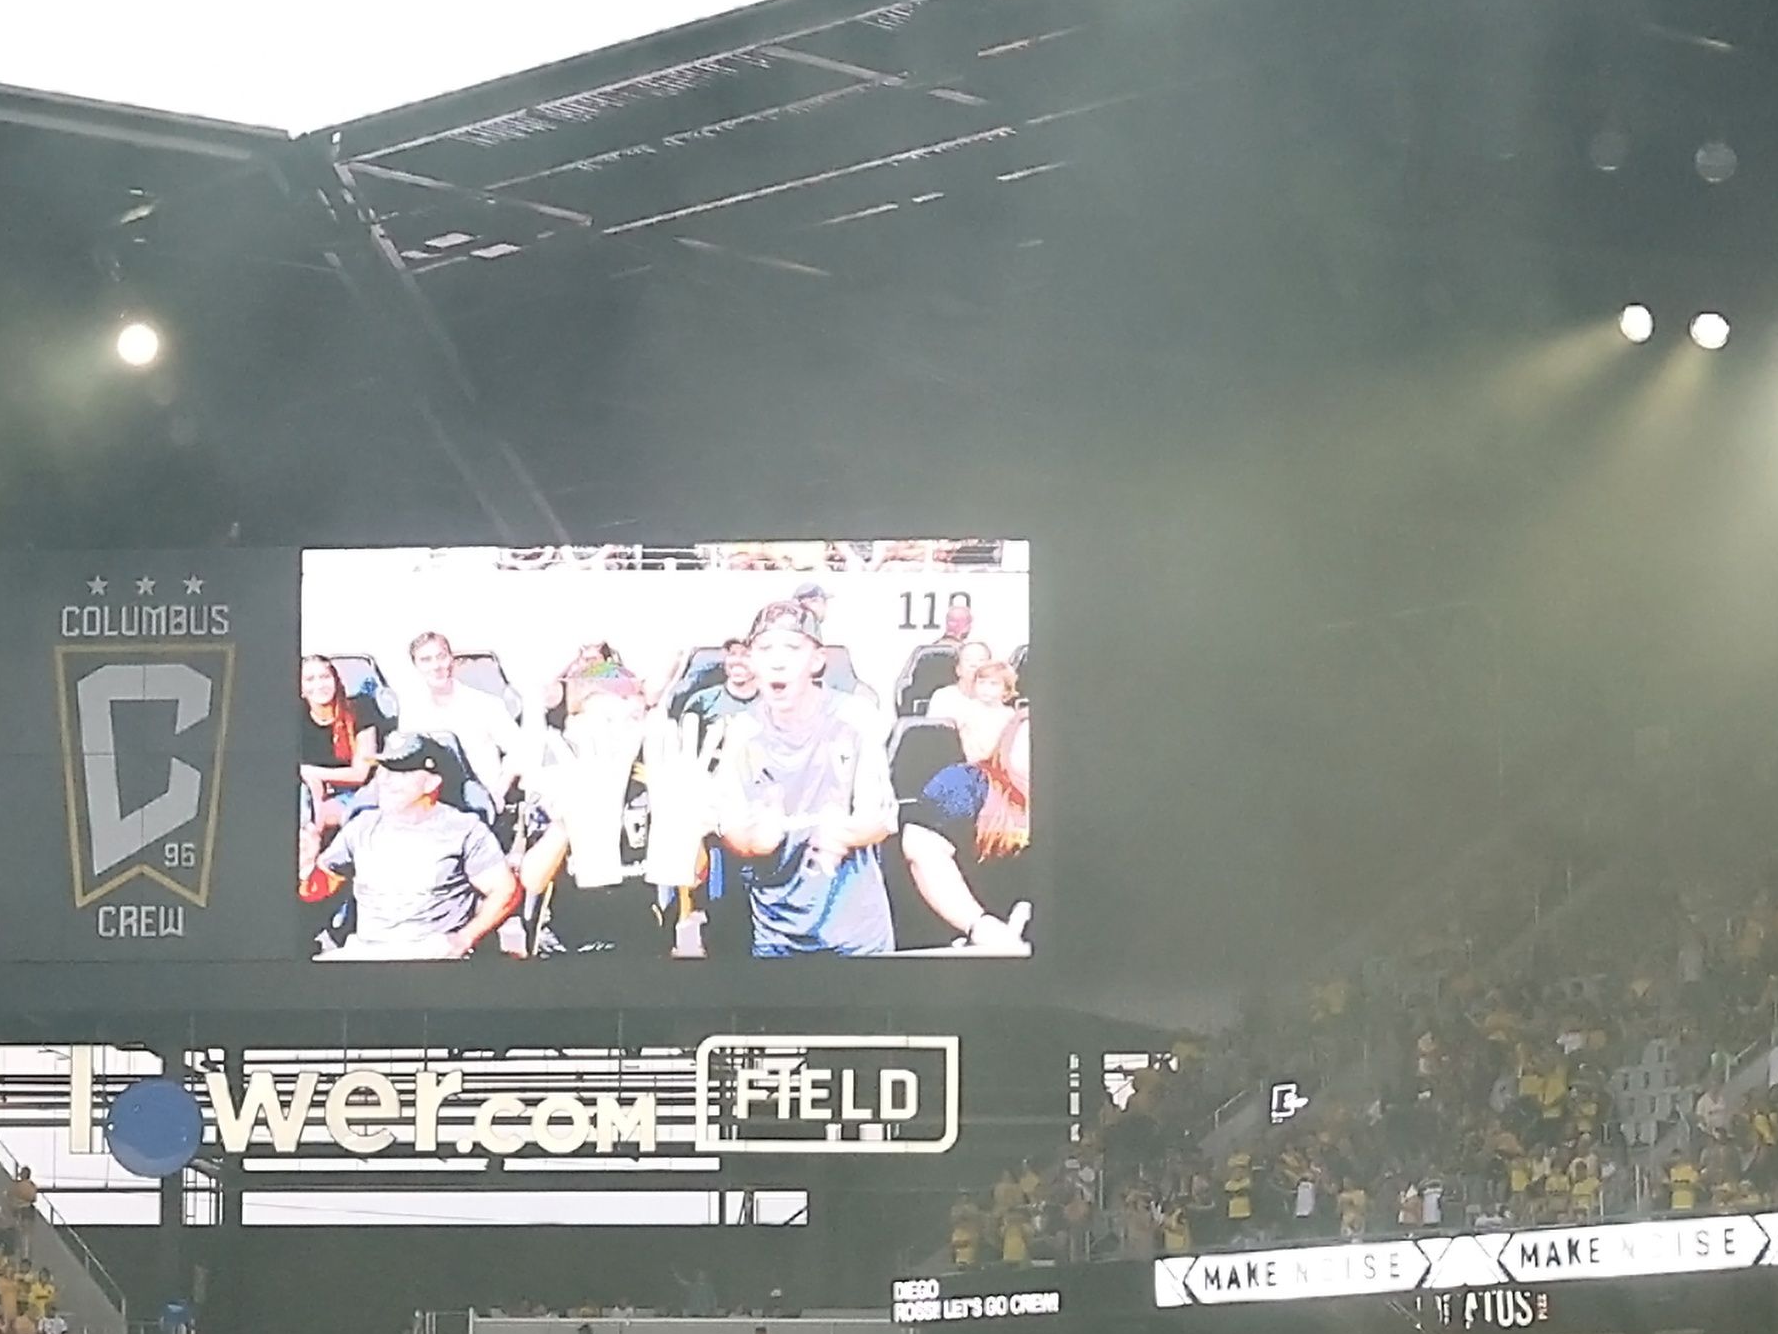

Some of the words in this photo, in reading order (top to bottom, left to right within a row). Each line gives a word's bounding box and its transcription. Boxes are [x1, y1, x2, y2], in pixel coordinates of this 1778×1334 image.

[60, 605, 230, 637] COLUMBUS
[163, 842, 196, 868] 96
[96, 905, 186, 938] CREW
[735, 1067, 920, 1121] FIELD
[1520, 1237, 1601, 1268] MAKE
[894, 1278, 940, 1301] DIEGO
[1202, 1260, 1278, 1291] MAKE
[943, 1297, 983, 1320] LET'S
[984, 1294, 1008, 1317] GO
